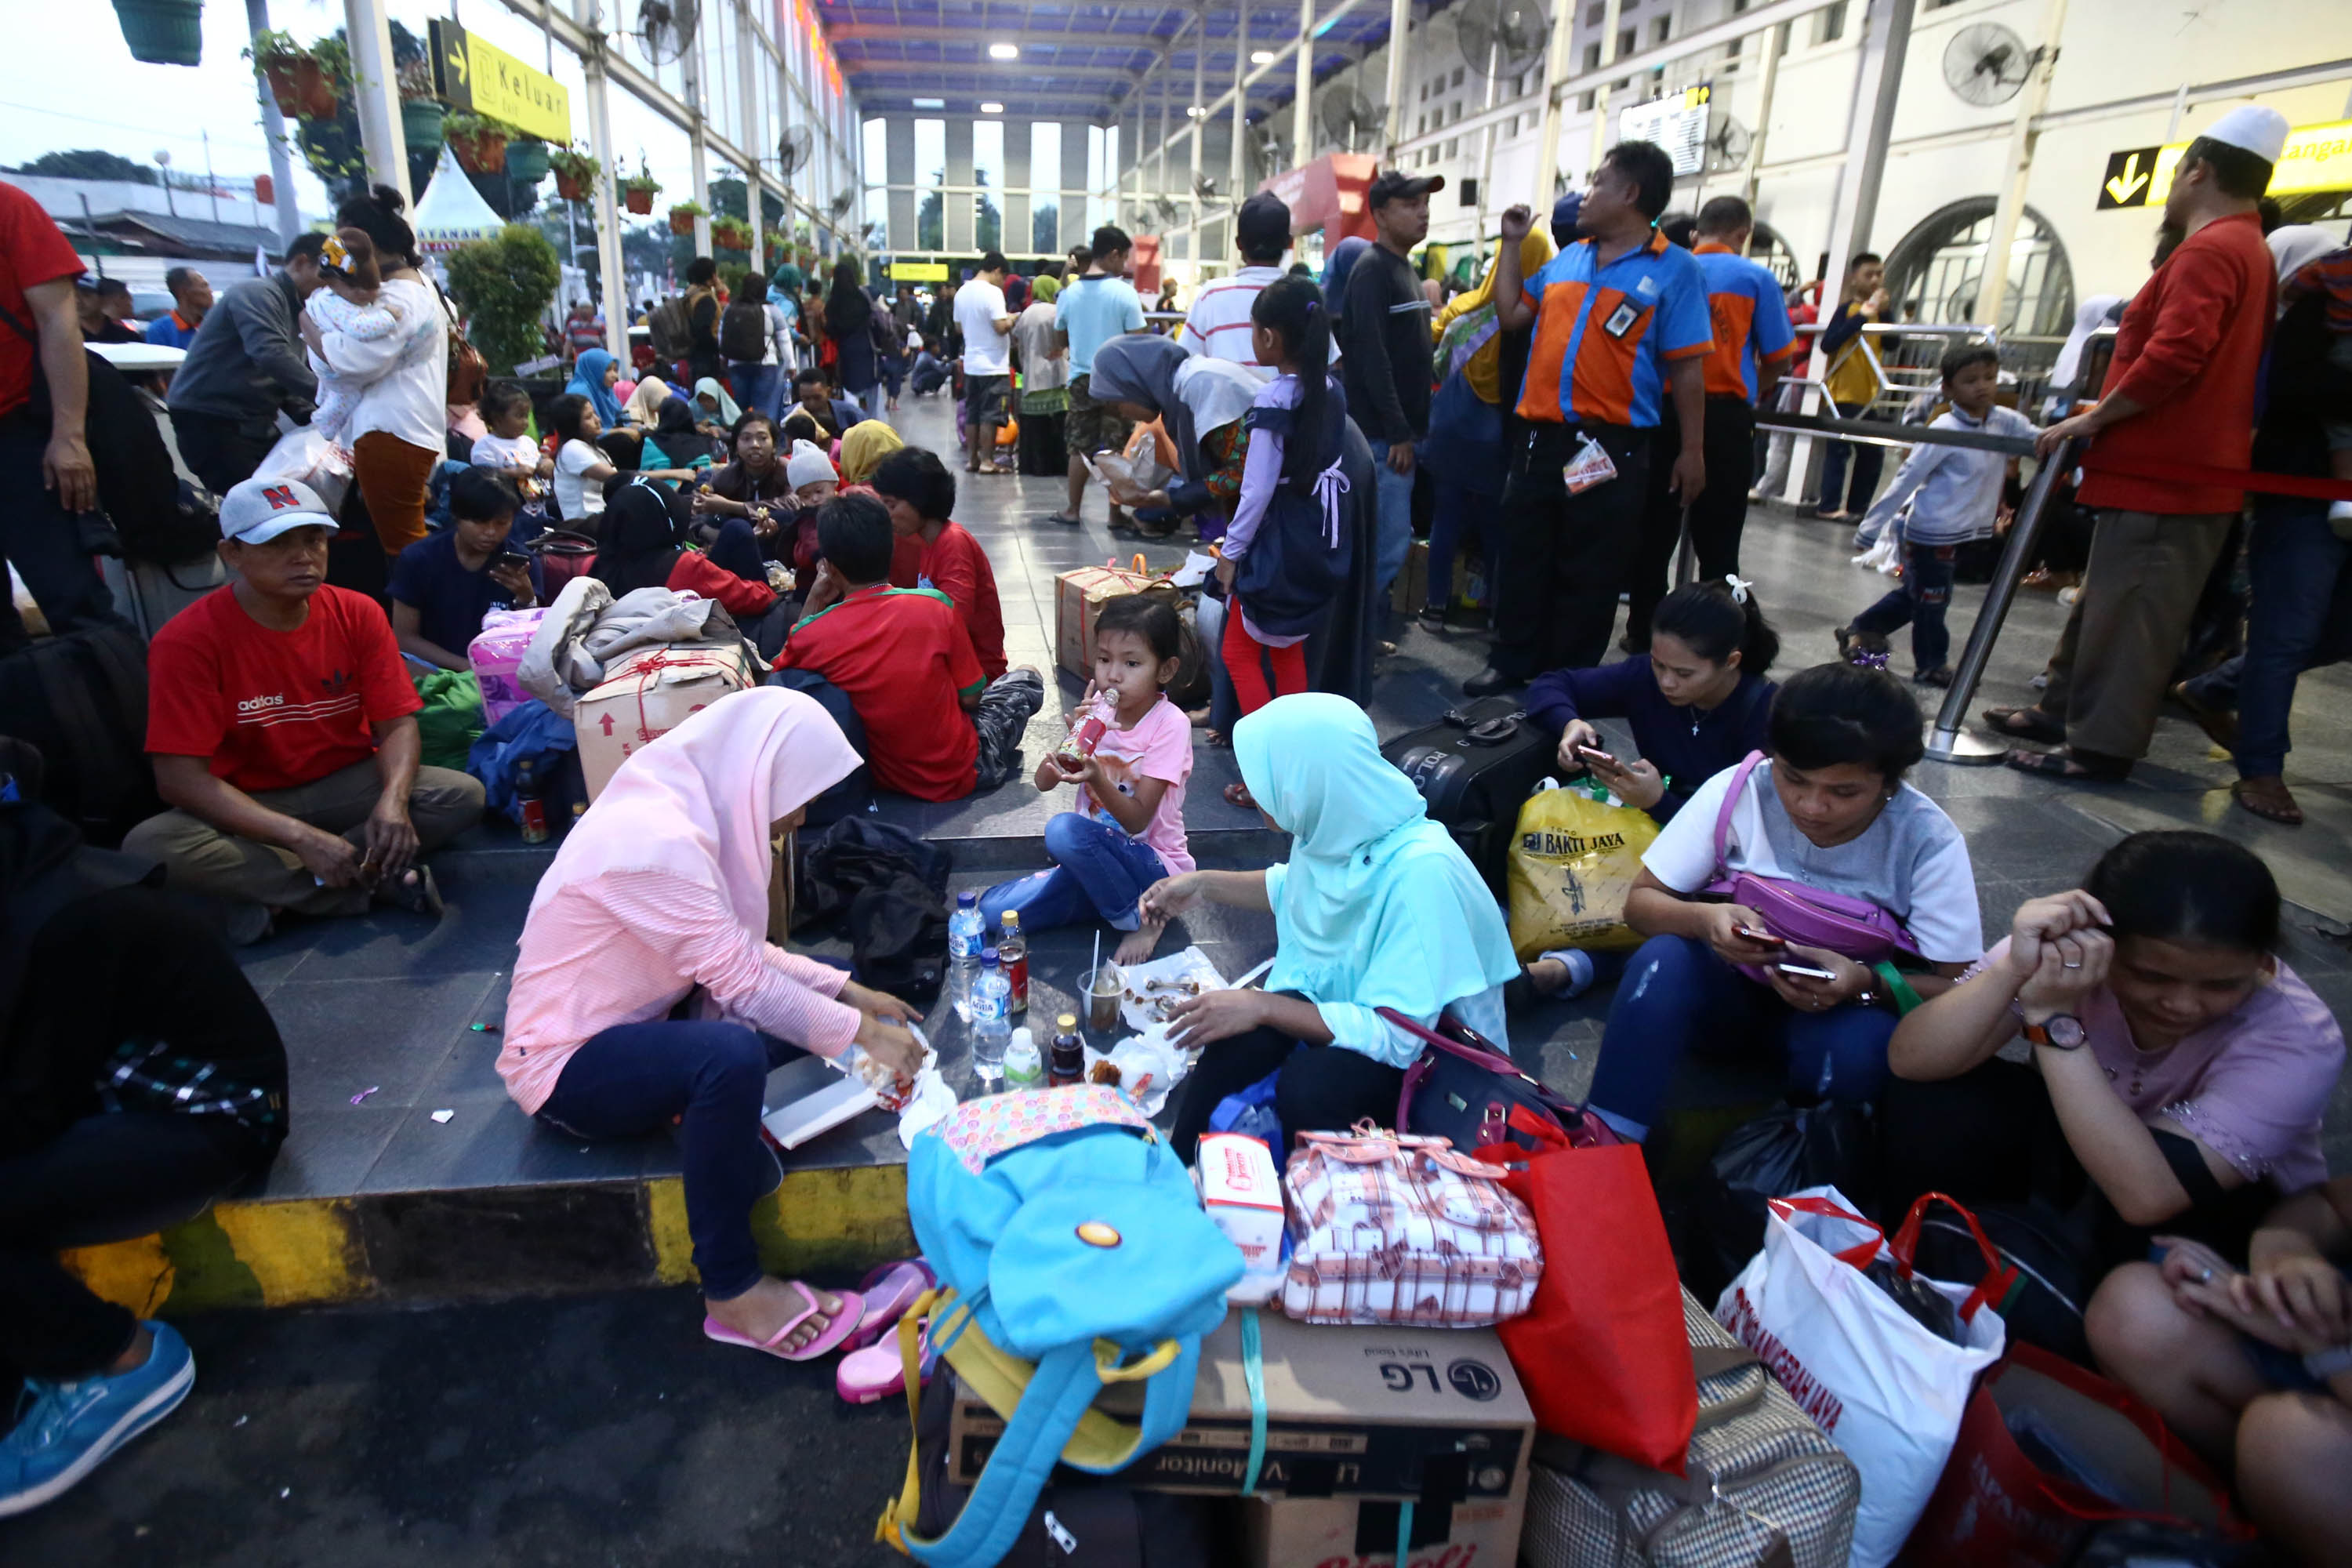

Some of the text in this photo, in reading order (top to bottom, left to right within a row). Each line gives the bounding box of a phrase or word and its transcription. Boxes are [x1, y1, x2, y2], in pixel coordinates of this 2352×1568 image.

[497, 60, 561, 114] Keluar
[262, 485, 299, 510] N
[238, 693, 284, 710] adidas
[1546, 833, 1585, 854] BAKTI
[1591, 833, 1625, 850] JAYA
[1379, 1362, 1442, 1392] LG
